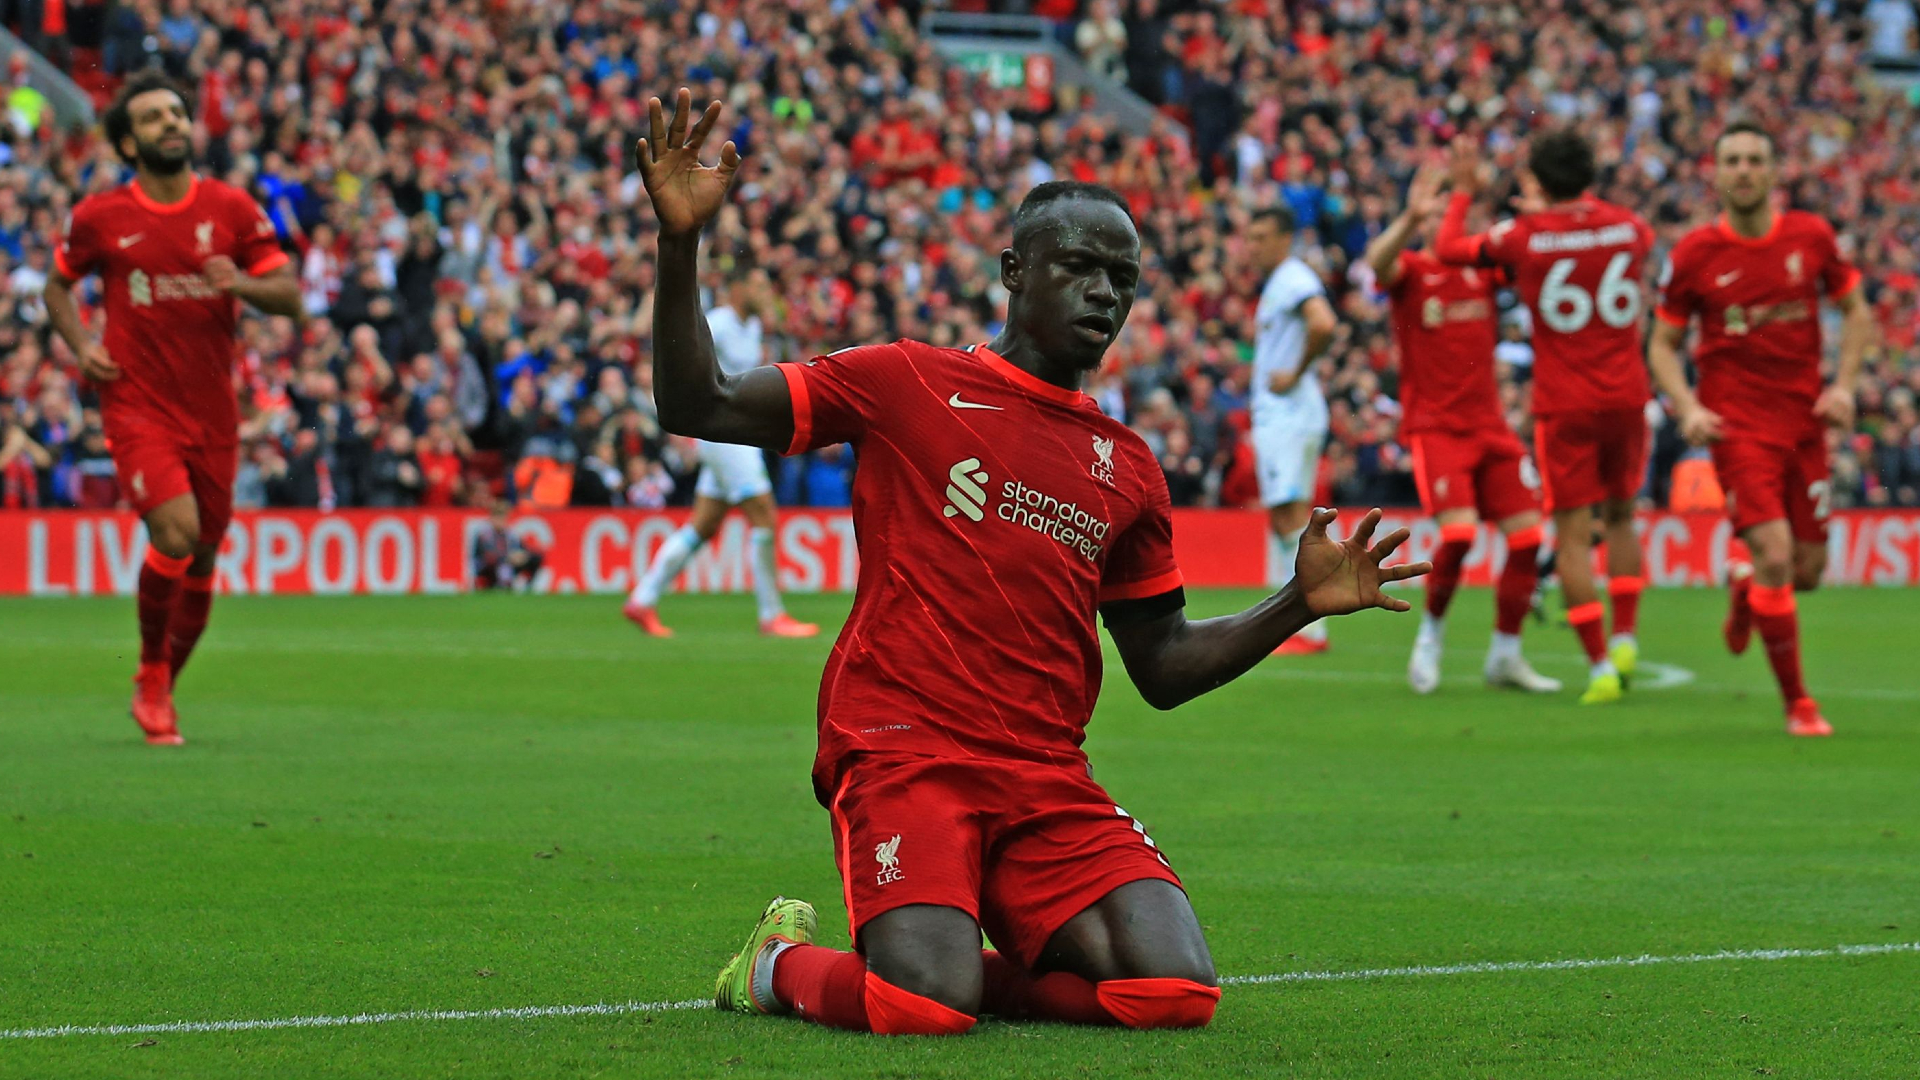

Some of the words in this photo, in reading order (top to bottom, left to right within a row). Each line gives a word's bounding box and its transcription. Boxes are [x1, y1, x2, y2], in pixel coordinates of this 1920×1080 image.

[1538, 251, 1643, 334] 66
[997, 502, 1104, 562] chartered
[1002, 481, 1110, 541] standard
[876, 869, 906, 887] L.F.C.
